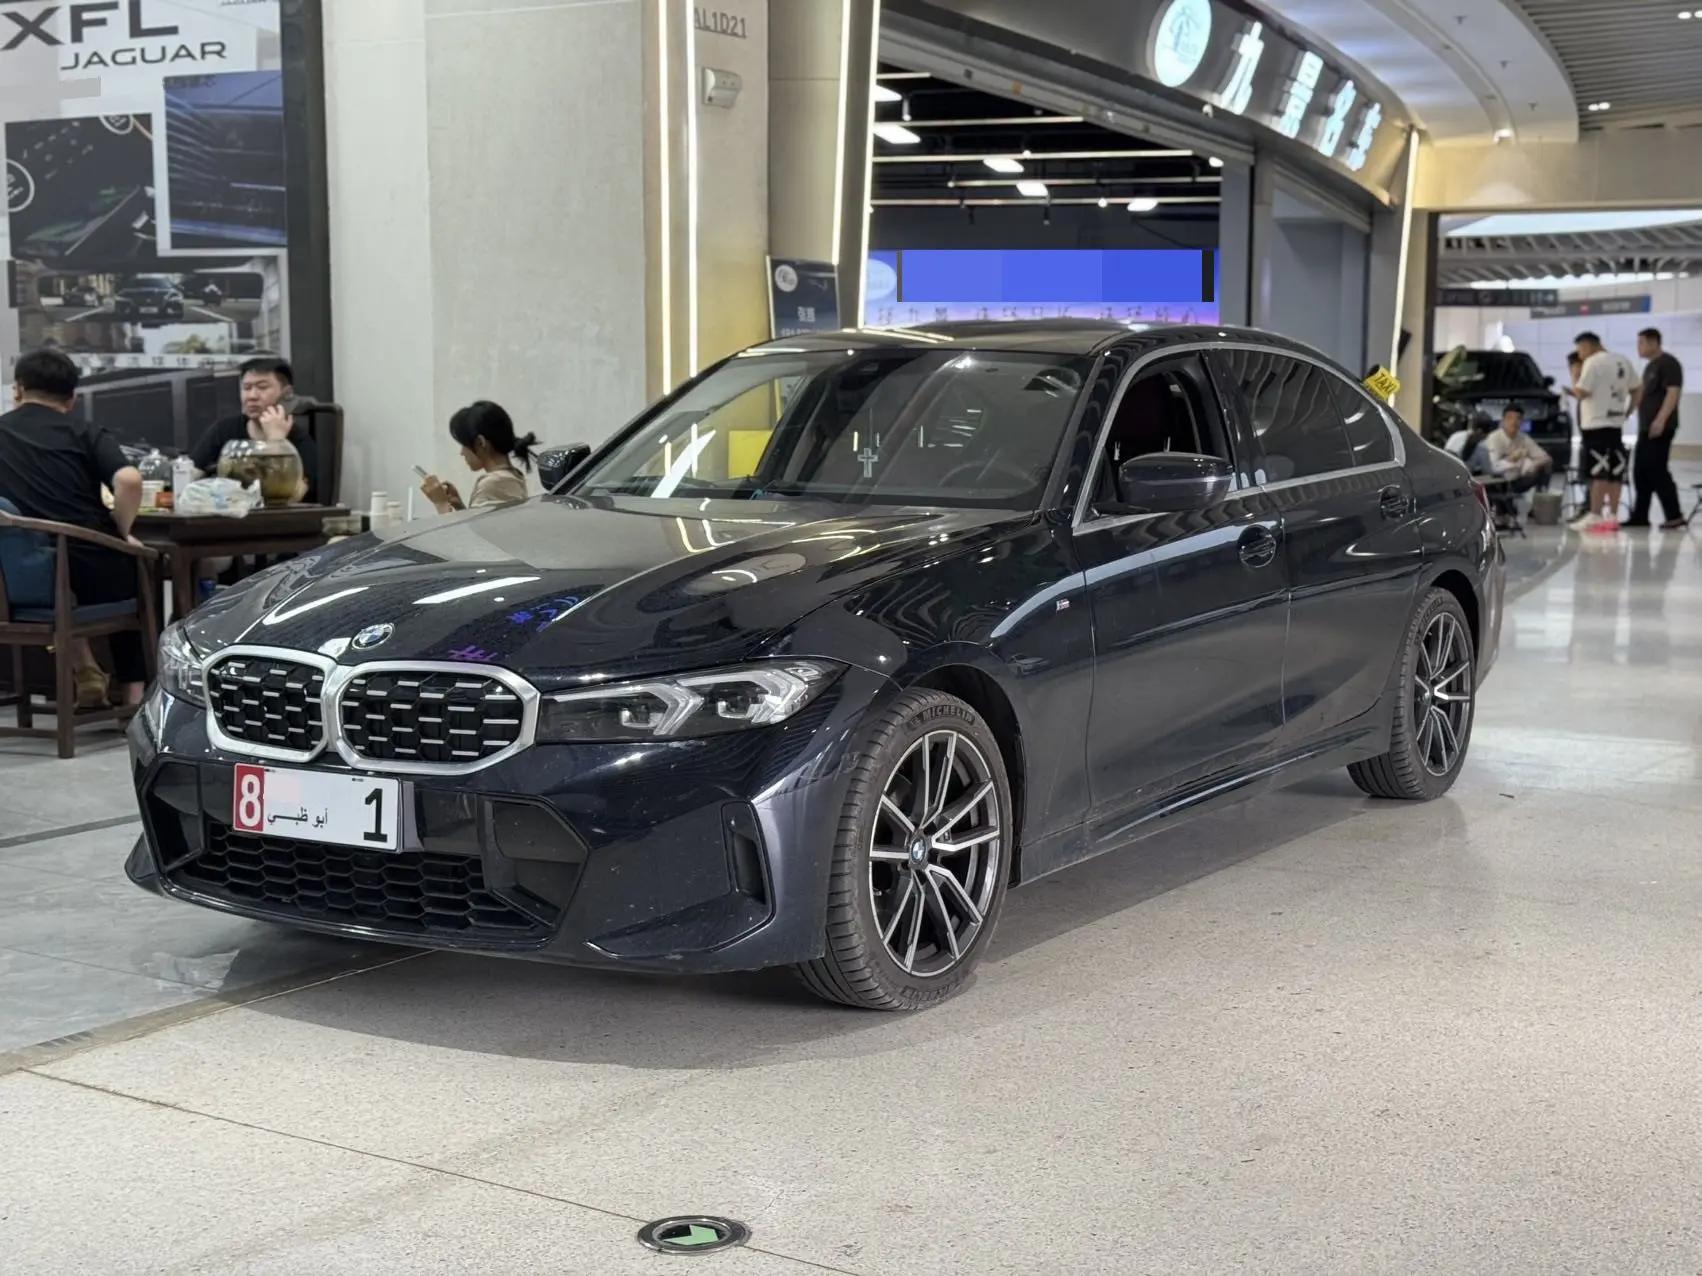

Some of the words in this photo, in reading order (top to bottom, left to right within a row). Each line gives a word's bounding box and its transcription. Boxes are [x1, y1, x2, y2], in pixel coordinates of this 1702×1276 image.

[0, 0, 179, 50] XFL
[60, 41, 228, 70] JAGUAR
[239, 774, 261, 827] 8
[363, 788, 388, 843] 1
[312, 808, 328, 828] أبو
